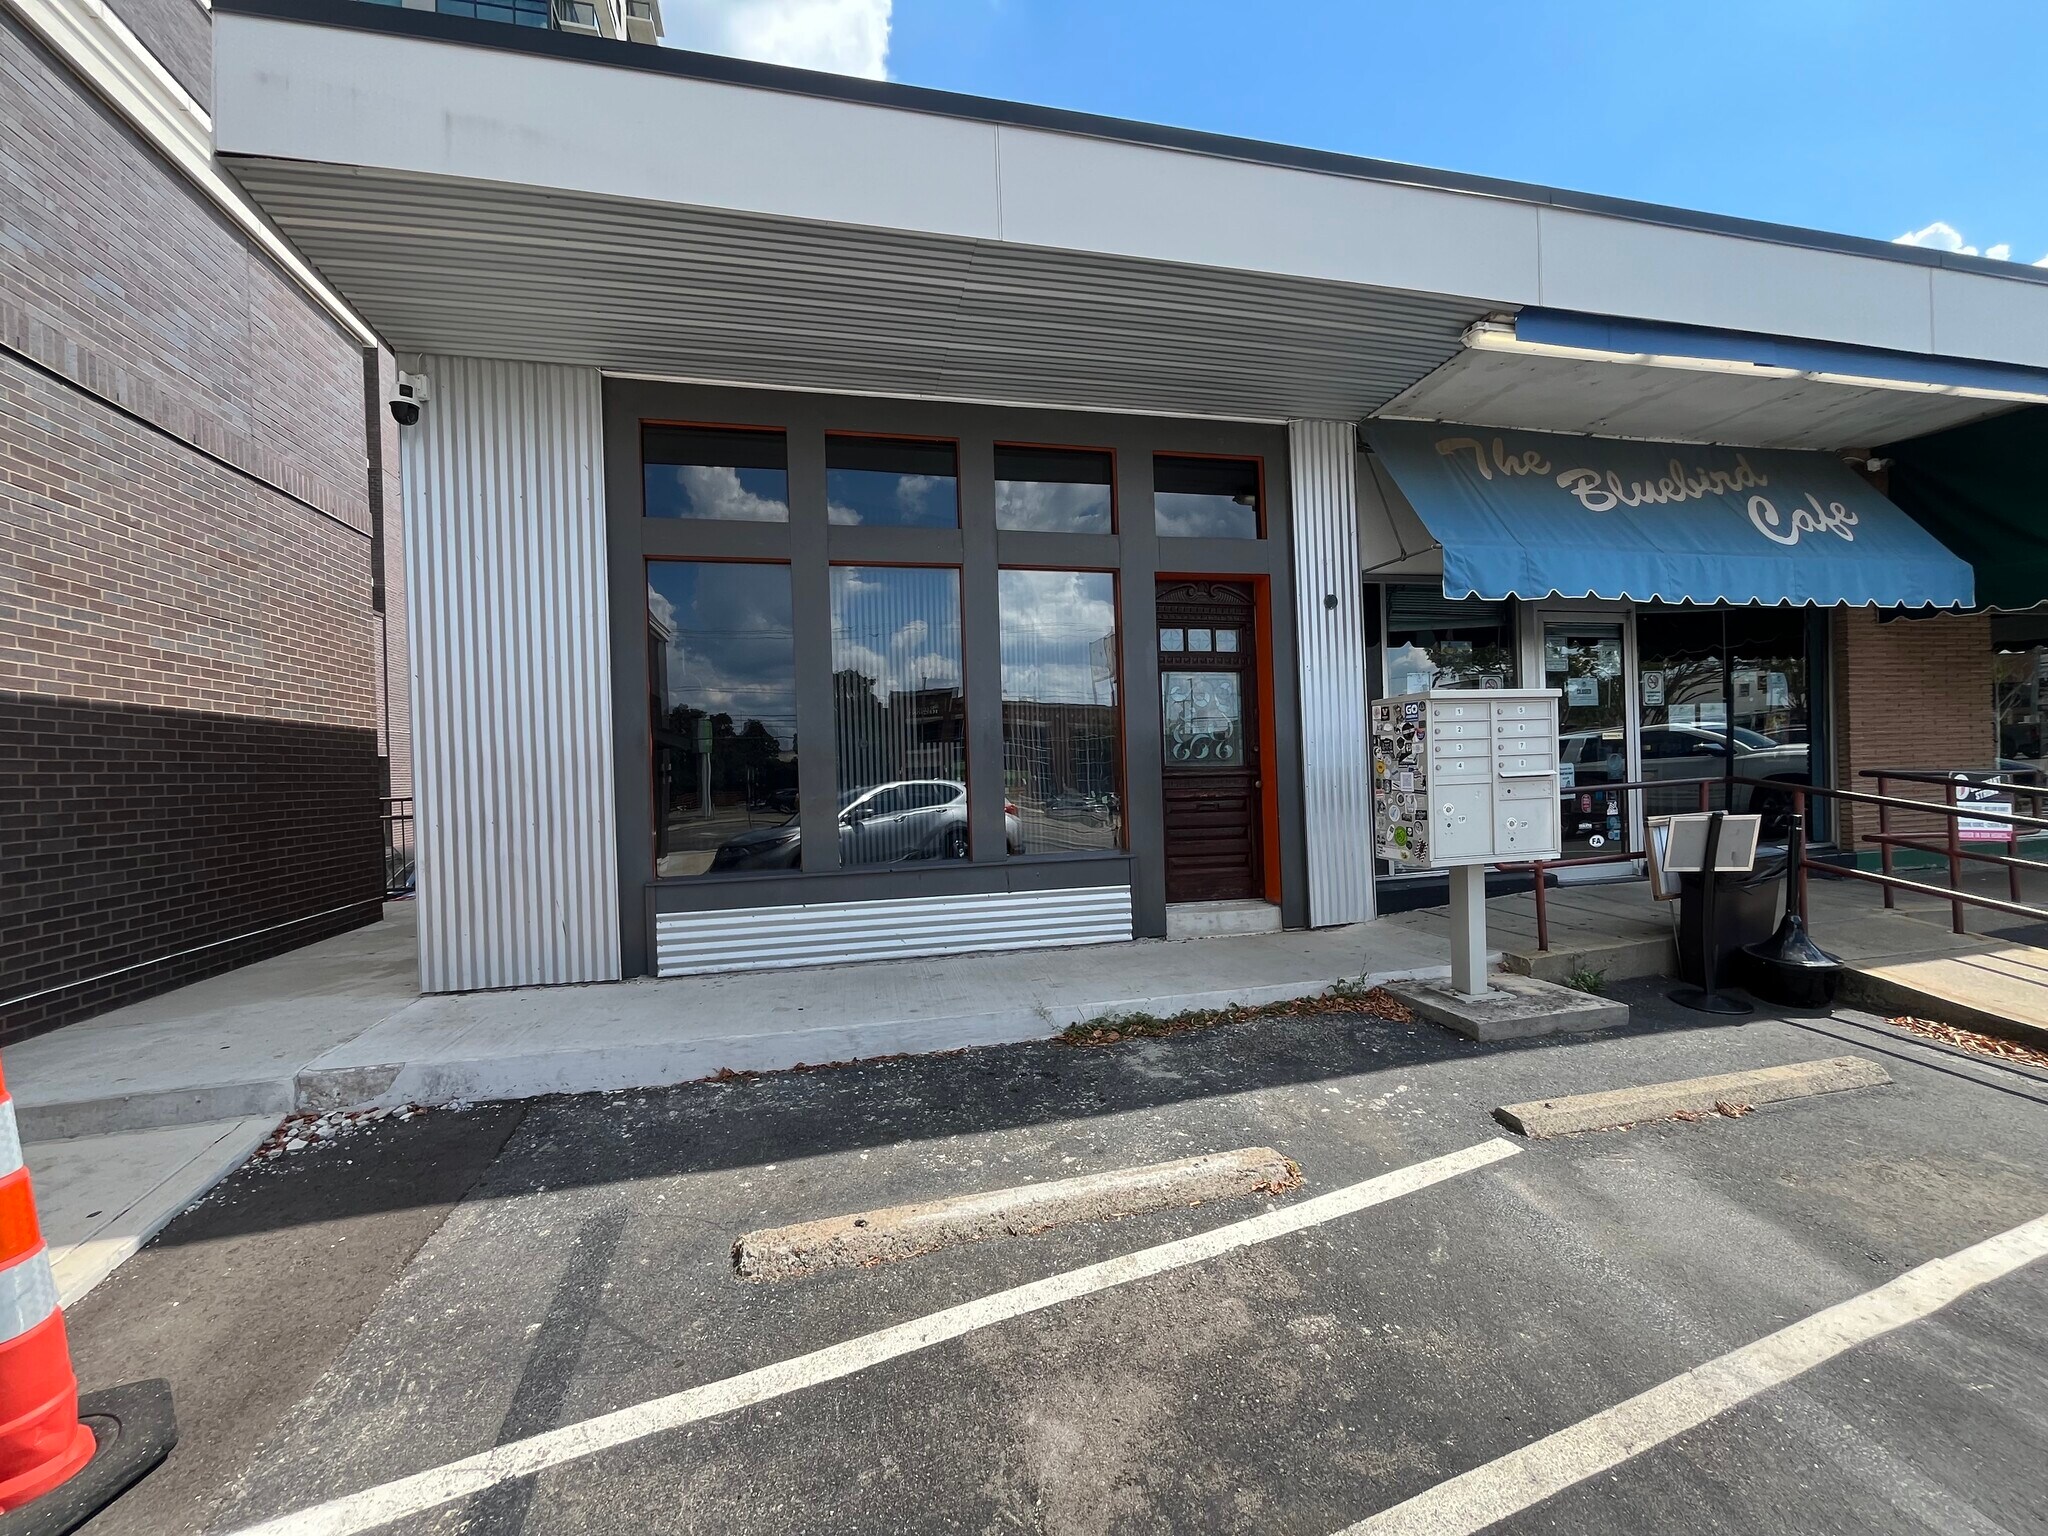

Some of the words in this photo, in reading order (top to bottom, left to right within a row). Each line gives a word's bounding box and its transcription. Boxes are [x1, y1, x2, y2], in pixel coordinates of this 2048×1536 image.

[1435, 437, 1551, 480] The
[1556, 453, 1768, 512] Bluebird
[1747, 492, 1859, 545] Cafe
[1405, 704, 1418, 714] GO
[1591, 837, 1602, 845] FA
